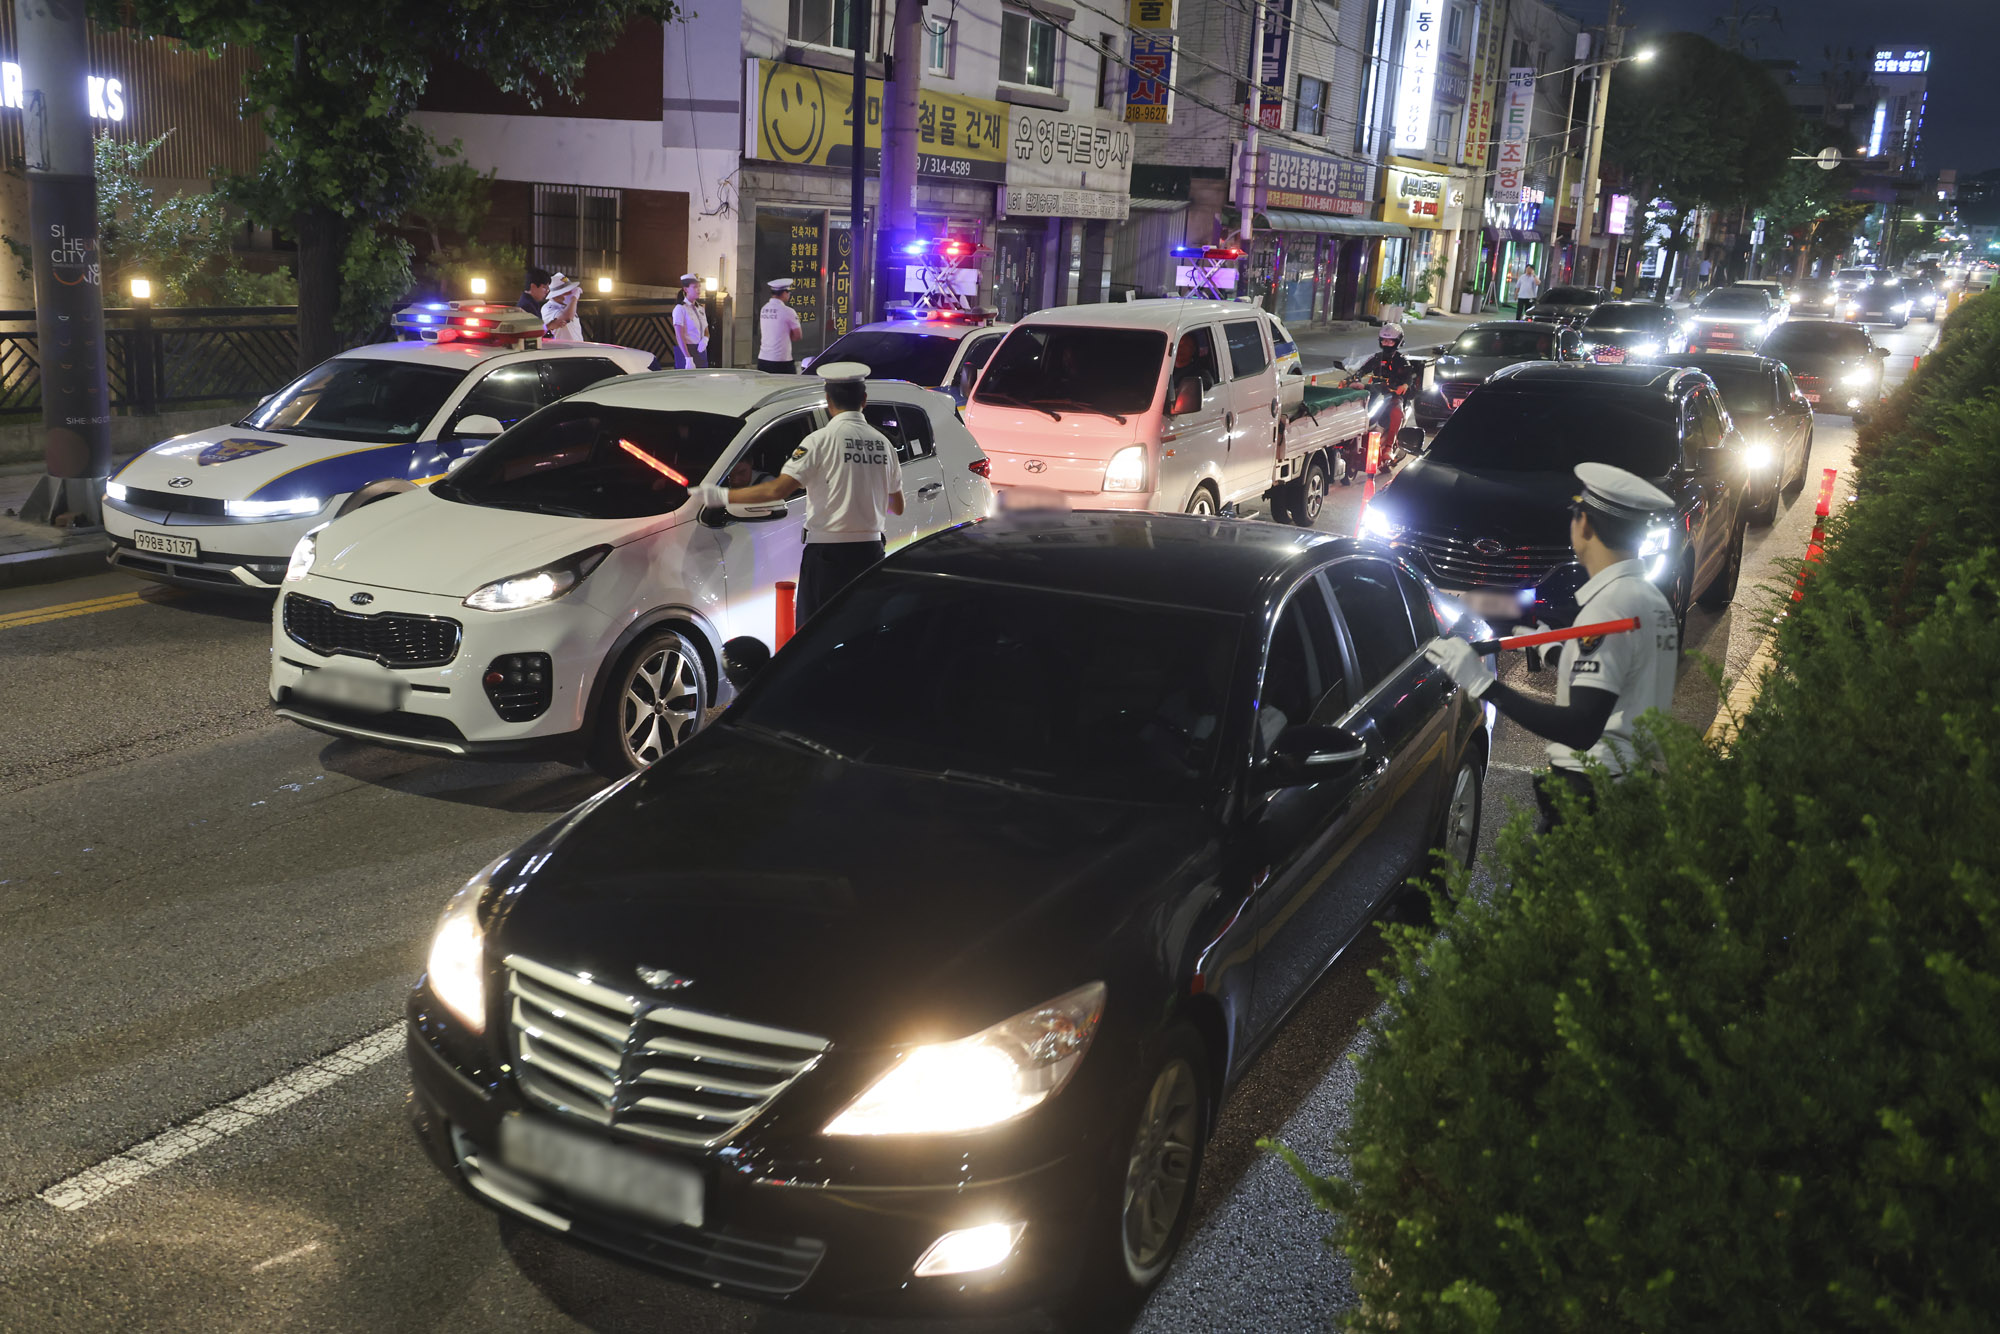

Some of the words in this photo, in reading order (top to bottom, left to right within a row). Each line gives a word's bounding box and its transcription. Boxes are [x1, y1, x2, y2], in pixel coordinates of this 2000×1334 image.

[1414, 0, 1434, 58] 동산
[1126, 106, 1167, 121] 318-9627
[1244, 108, 1281, 127] 3-9547
[966, 110, 1001, 149] 건재
[1015, 116, 1129, 169] 유영닥트공사
[930, 161, 971, 176] 314-4589
[51, 224, 65, 238] SI
[791, 226, 818, 238] 건축자재
[51, 249, 86, 263] CITY
[791, 243, 818, 256] 종합철물
[789, 295, 816, 307] 수도부속
[844, 438, 885, 452] 교통경찰
[844, 453, 888, 465] POLICE
[166, 538, 193, 555] 3137
